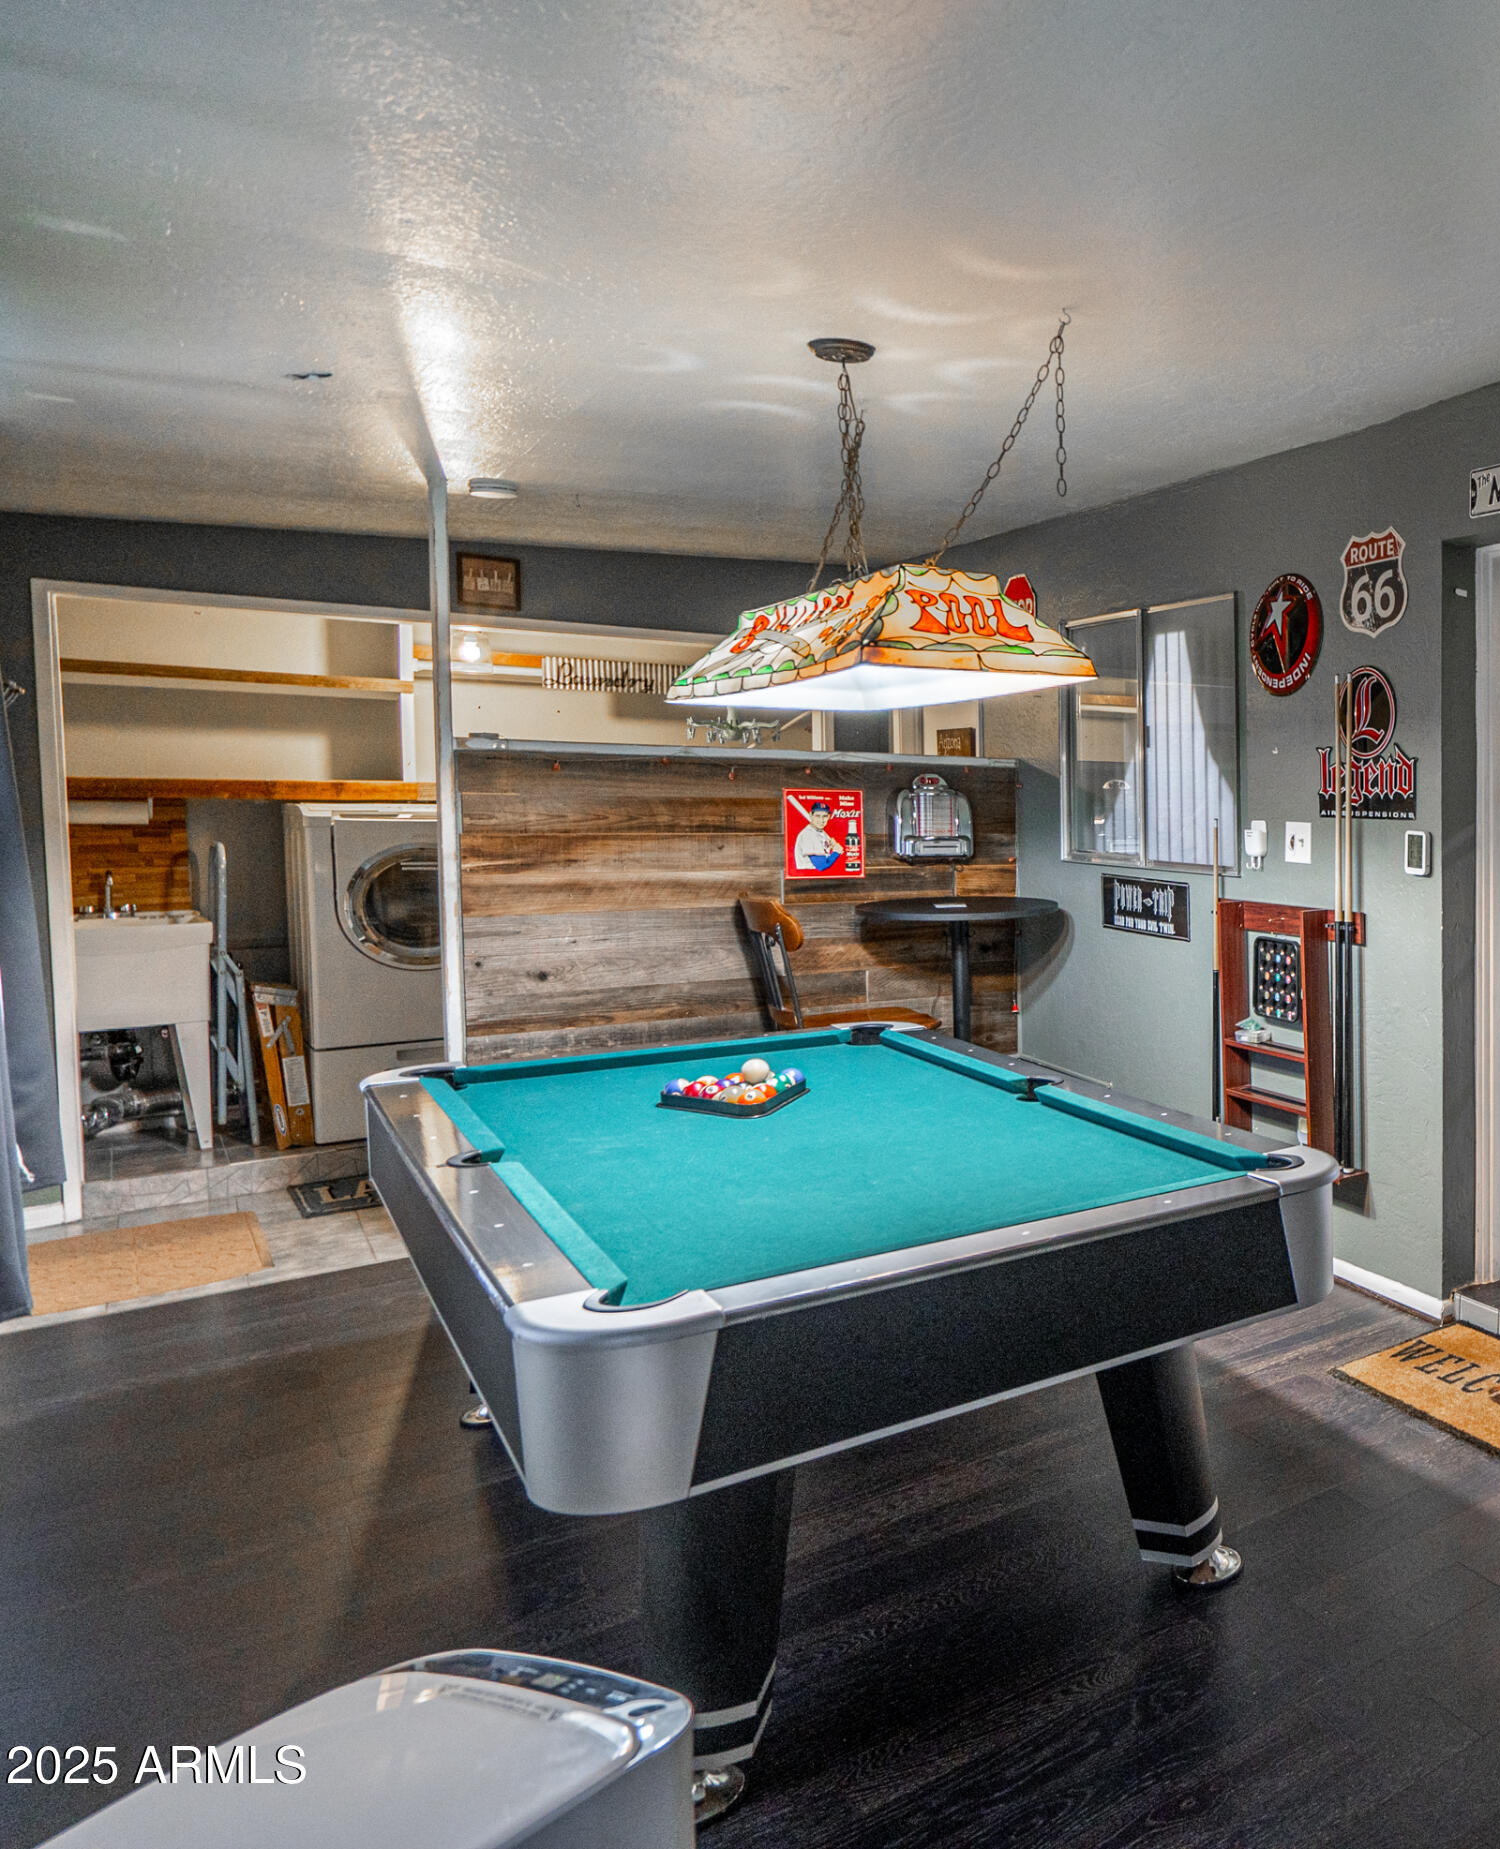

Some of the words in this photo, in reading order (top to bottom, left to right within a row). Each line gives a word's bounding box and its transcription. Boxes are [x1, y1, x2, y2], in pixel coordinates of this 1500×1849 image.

[1478, 473, 1491, 488] The
[1350, 538, 1395, 564] ROUTE
[1351, 569, 1396, 621] 66
[904, 589, 1033, 642] POOL
